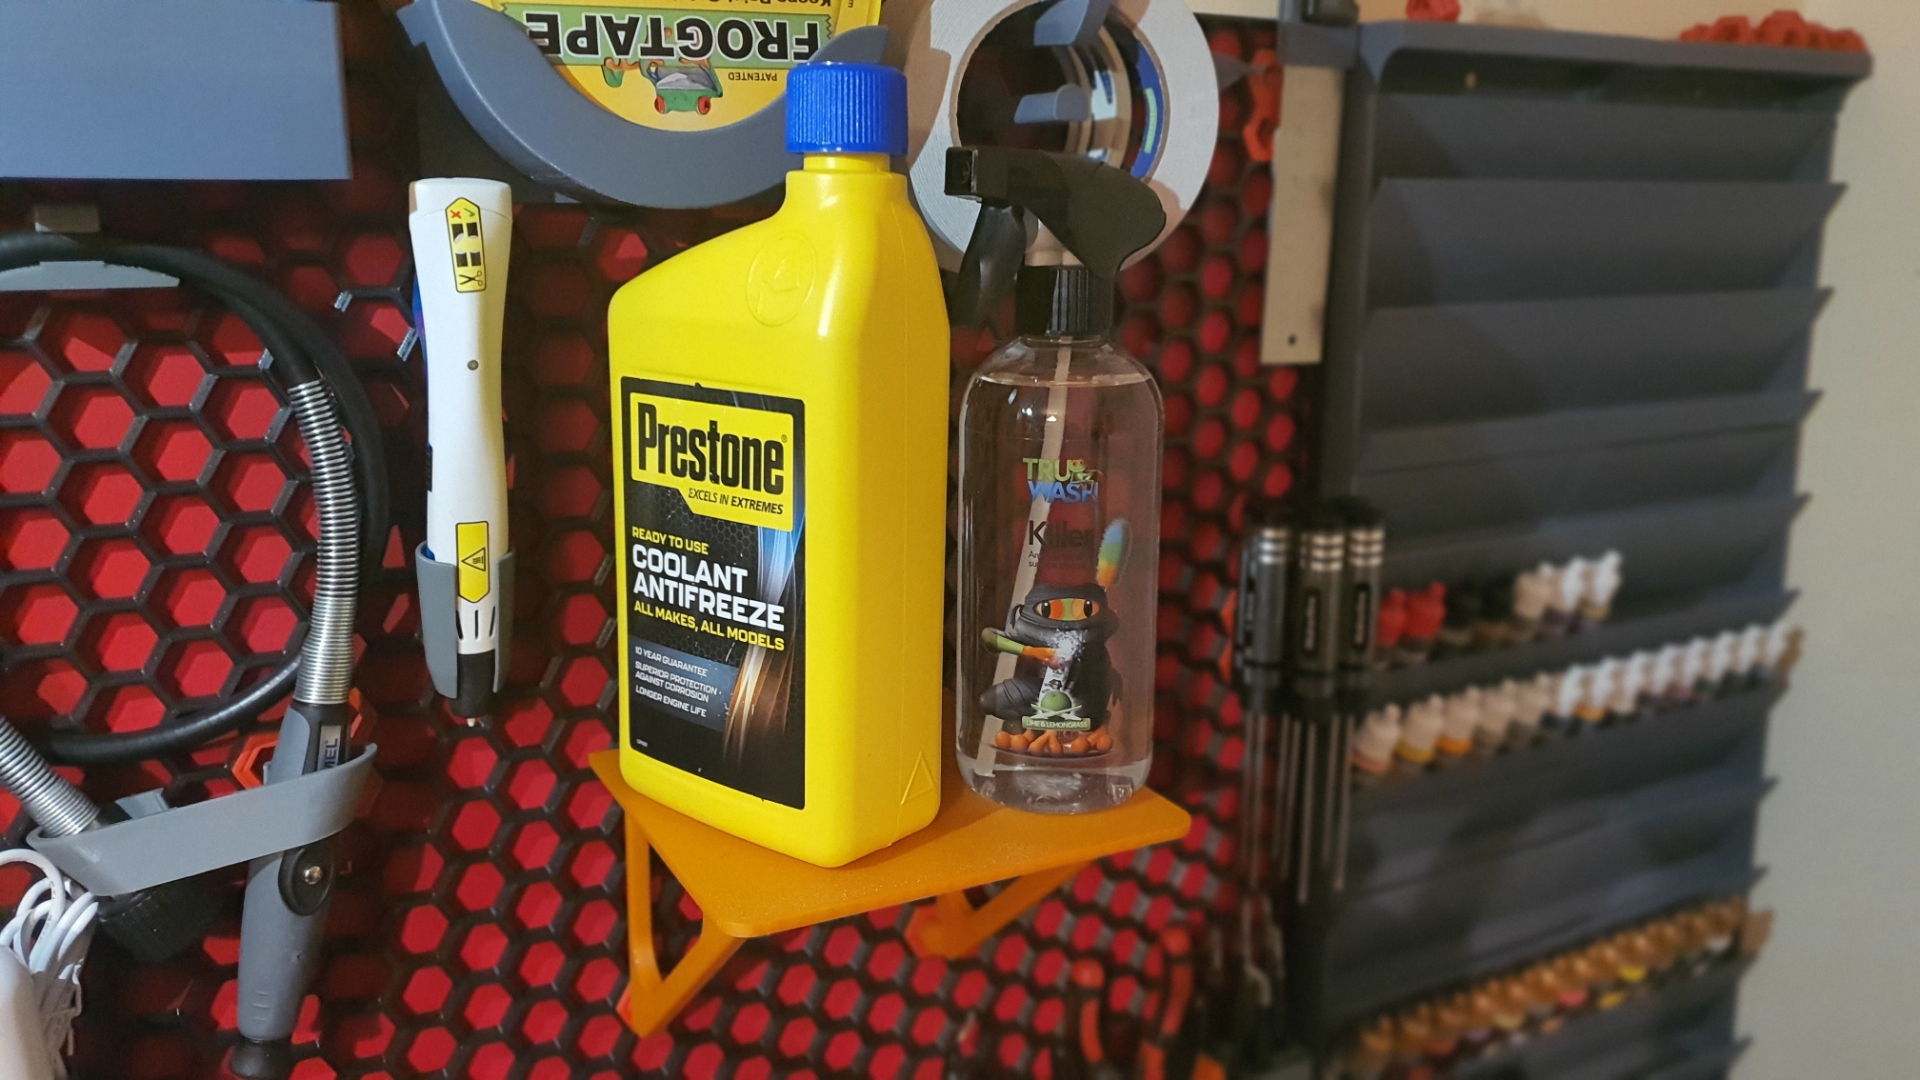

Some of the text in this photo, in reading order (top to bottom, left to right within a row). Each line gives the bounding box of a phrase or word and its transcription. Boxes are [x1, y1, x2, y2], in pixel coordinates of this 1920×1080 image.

[525, 12, 819, 61] FROGTAPE
[728, 71, 777, 82] PATENTED
[638, 402, 784, 495] Prestone
[688, 488, 784, 515] EXCELS IN EXTREMES
[1027, 480, 1099, 504] WASH
[631, 526, 709, 555] READY TO USE
[632, 543, 748, 593] COOLANT
[633, 571, 785, 632] ANTIFREEZE
[634, 600, 785, 651] ALL MAKES, ALL MODELS
[635, 646, 709, 677] 10 YEAR GUARANTEE
[635, 660, 718, 695] SUPERIOR PROTECTION
[635, 671, 709, 703] AGAINST CORROSION
[635, 684, 707, 718] LONGER ENGINE LIFE
[324, 738, 339, 768] MEL
